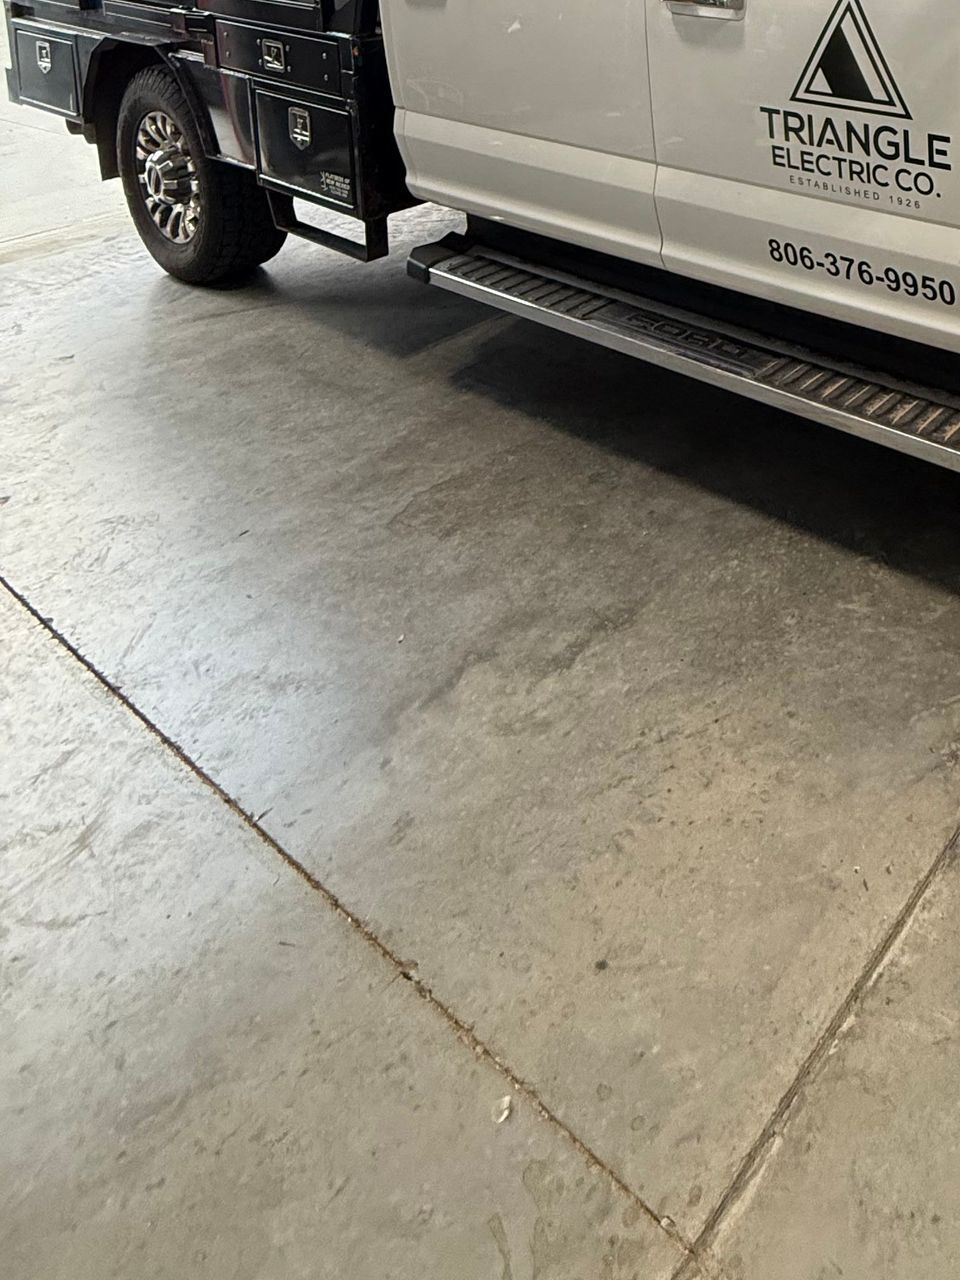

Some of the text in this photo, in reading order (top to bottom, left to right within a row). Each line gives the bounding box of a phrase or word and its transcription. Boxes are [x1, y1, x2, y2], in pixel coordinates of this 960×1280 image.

[760, 106, 951, 171] TRIANGLE
[771, 145, 942, 198] ELECTRIC CO.
[789, 175, 921, 209] ESTABLISHED 1926
[768, 238, 956, 306] 806-376-9950
